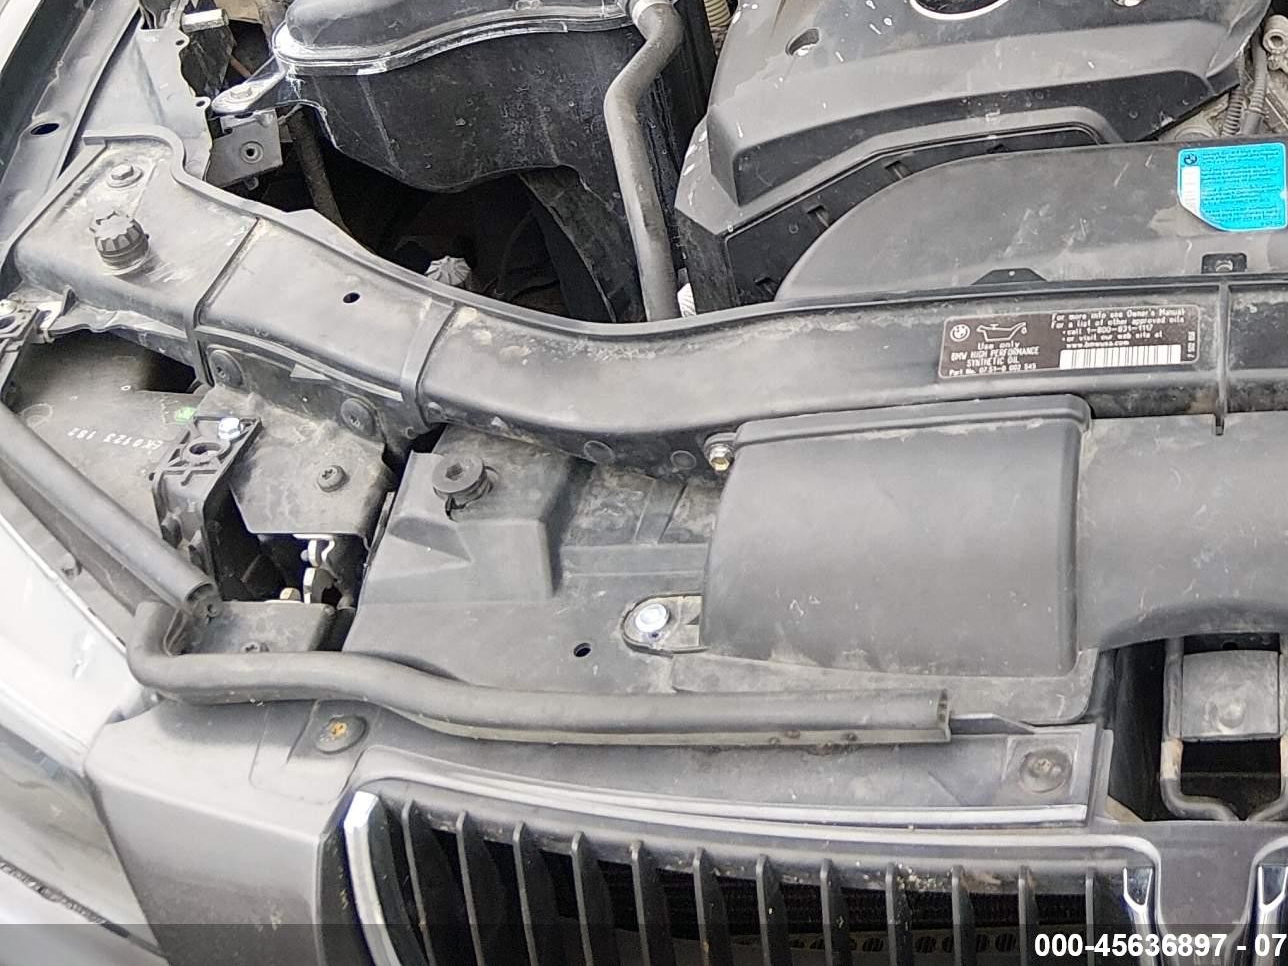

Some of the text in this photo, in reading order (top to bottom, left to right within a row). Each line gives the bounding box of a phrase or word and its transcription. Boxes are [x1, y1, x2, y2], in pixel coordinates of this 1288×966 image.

[978, 340, 1020, 350] Use only
[990, 346, 1040, 357] PERFORMANCE
[966, 356, 1020, 368] SYNTHETIC OIL
